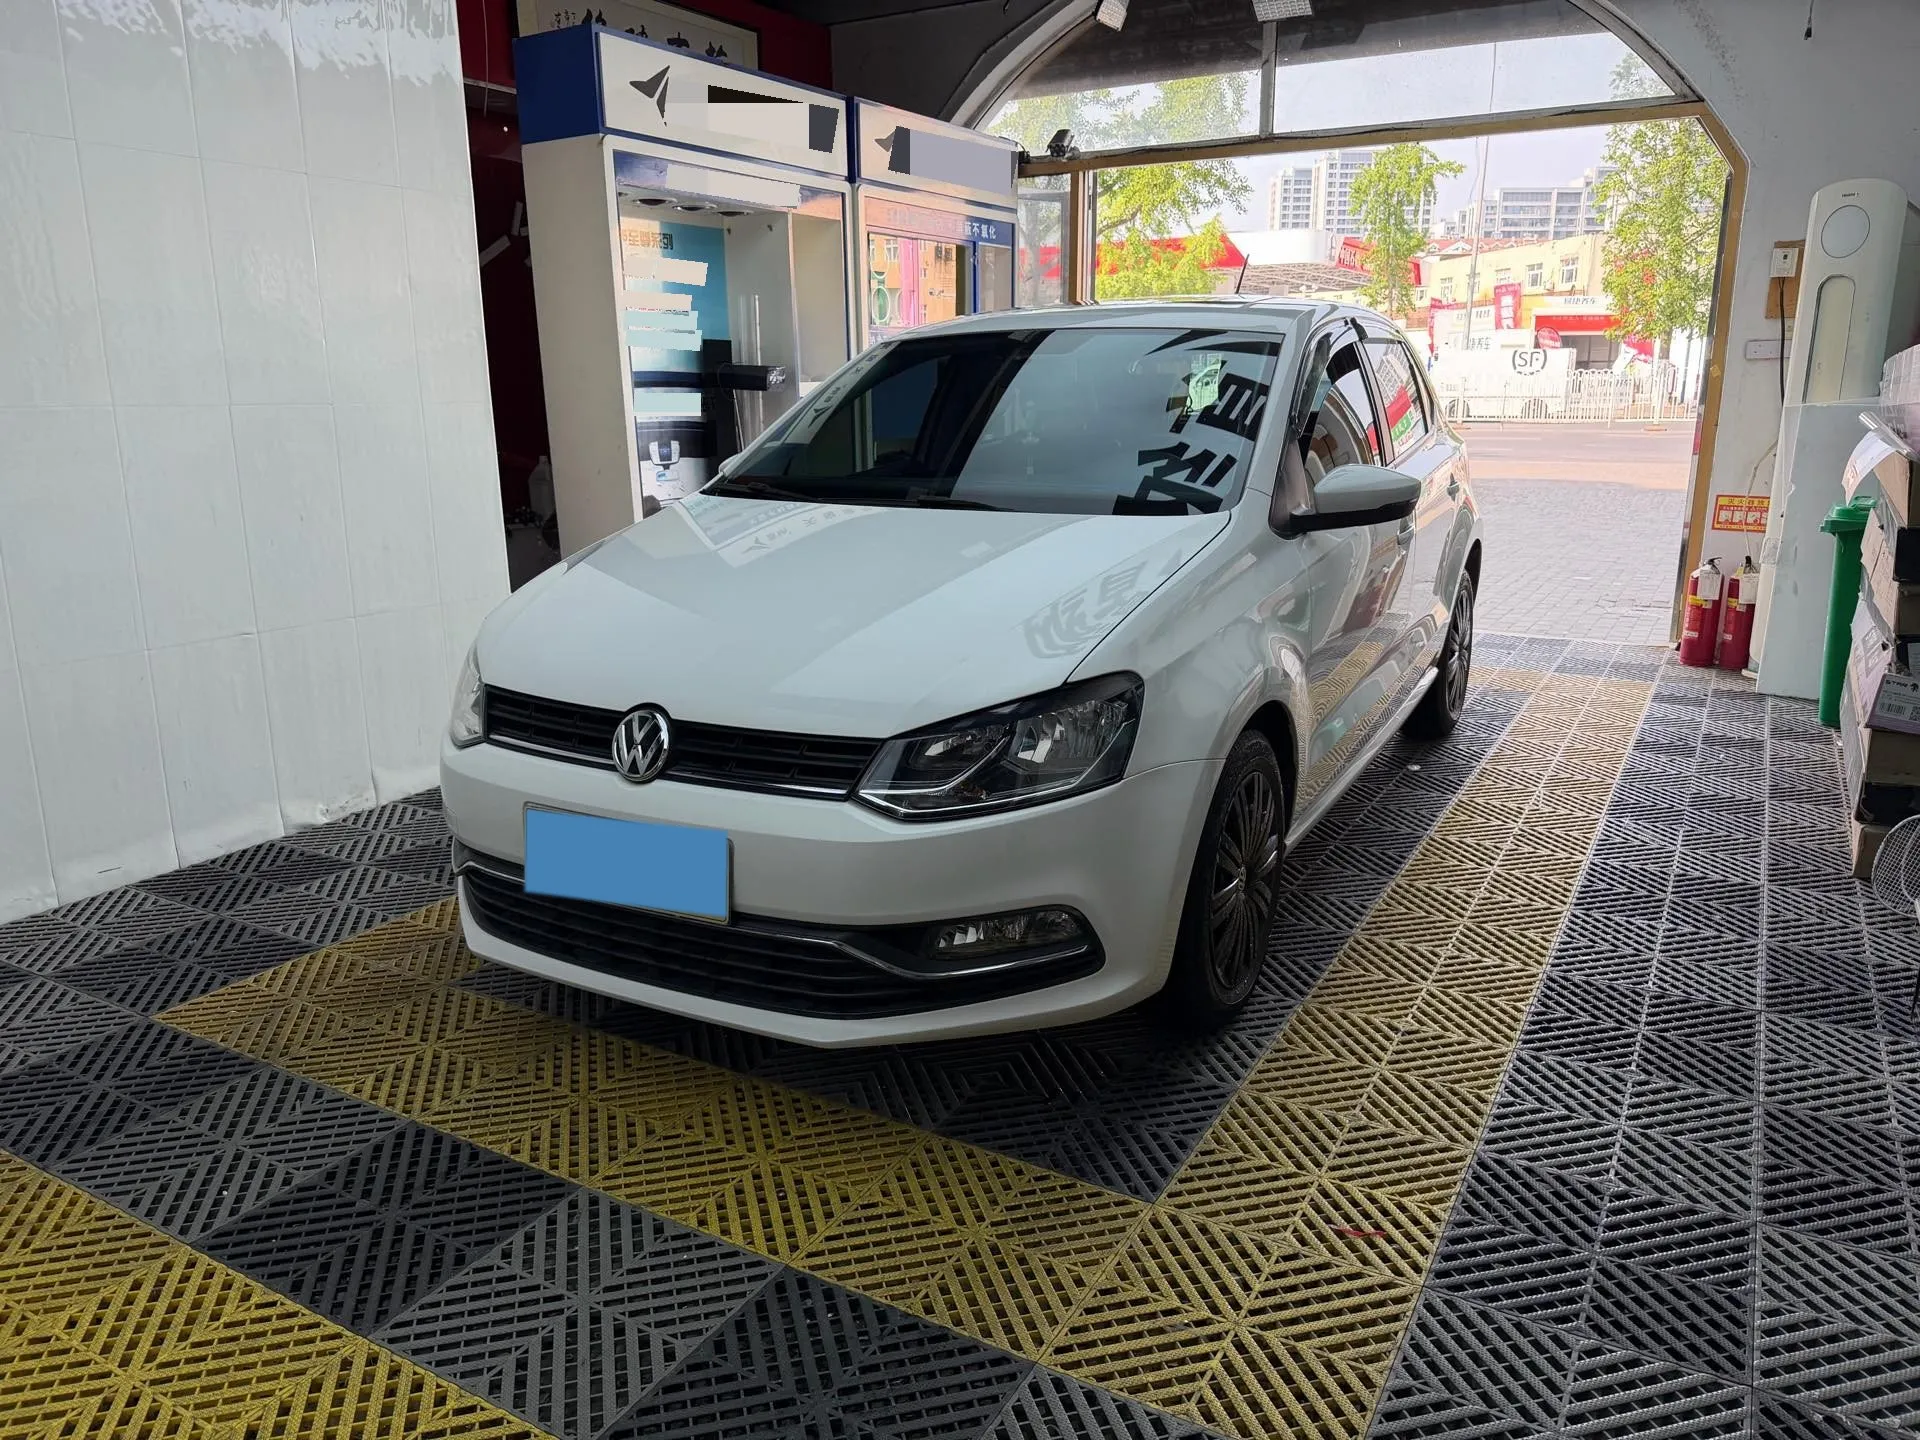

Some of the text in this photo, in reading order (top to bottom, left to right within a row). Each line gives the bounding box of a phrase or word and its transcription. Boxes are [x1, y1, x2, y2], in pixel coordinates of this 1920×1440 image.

[1517, 351, 1541, 367] SF
[1728, 498, 1770, 506] 灭火器放
